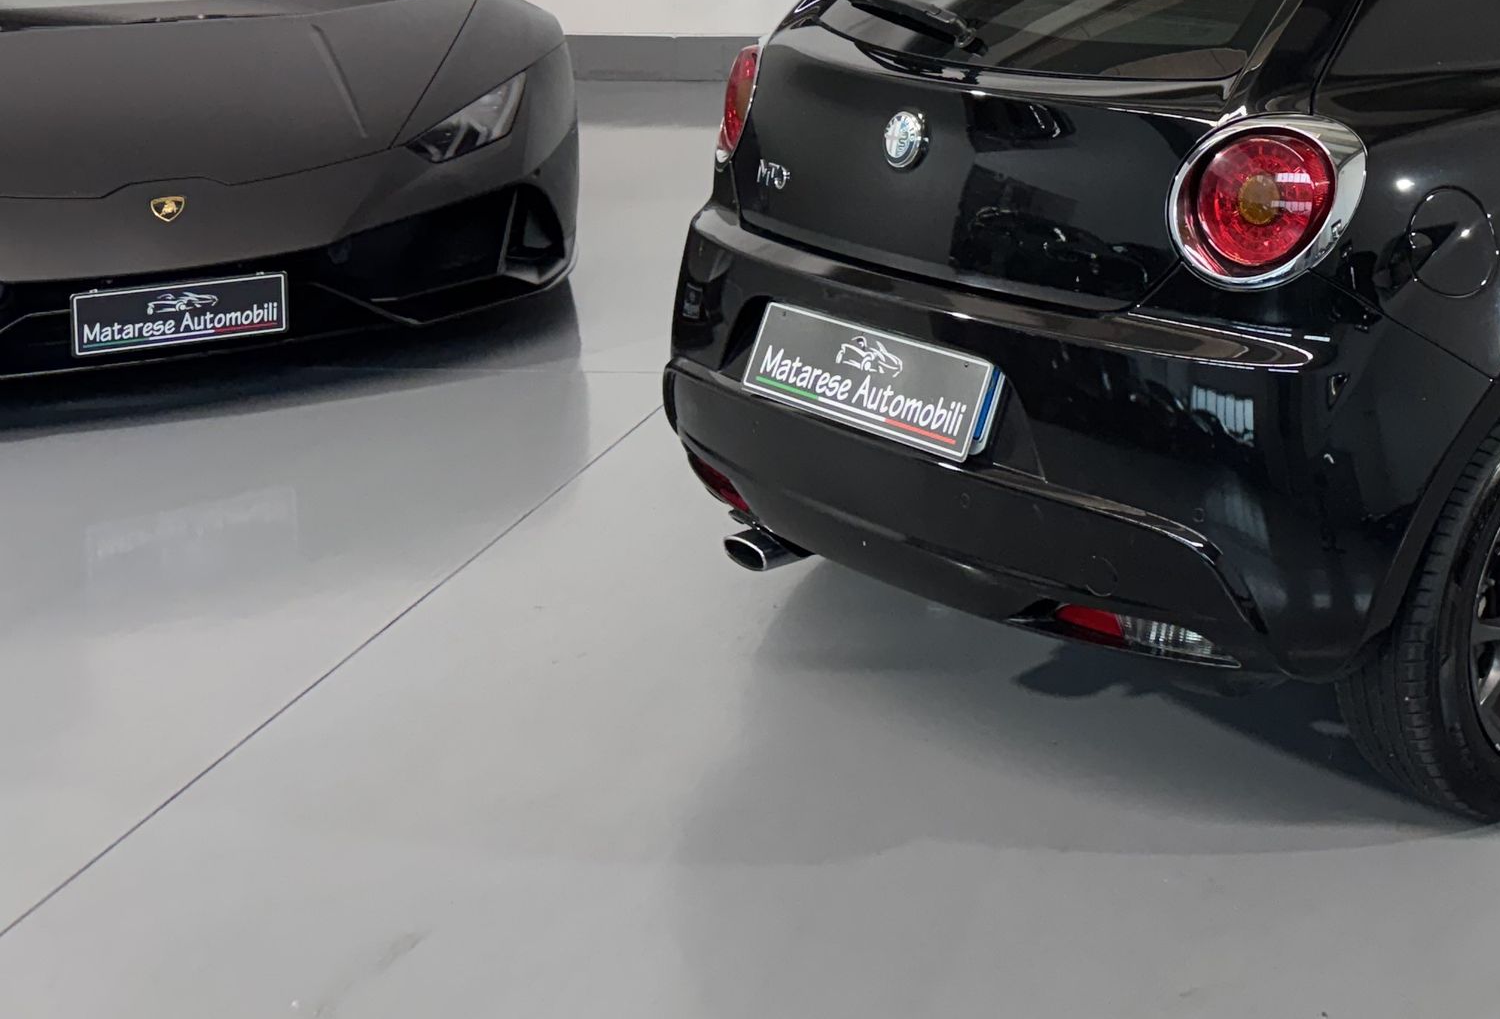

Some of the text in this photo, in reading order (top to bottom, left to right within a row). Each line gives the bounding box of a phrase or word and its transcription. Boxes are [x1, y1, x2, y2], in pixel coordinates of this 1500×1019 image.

[83, 302, 278, 343] Matarese Automobili
[760, 345, 967, 436] Matarese Automobili
